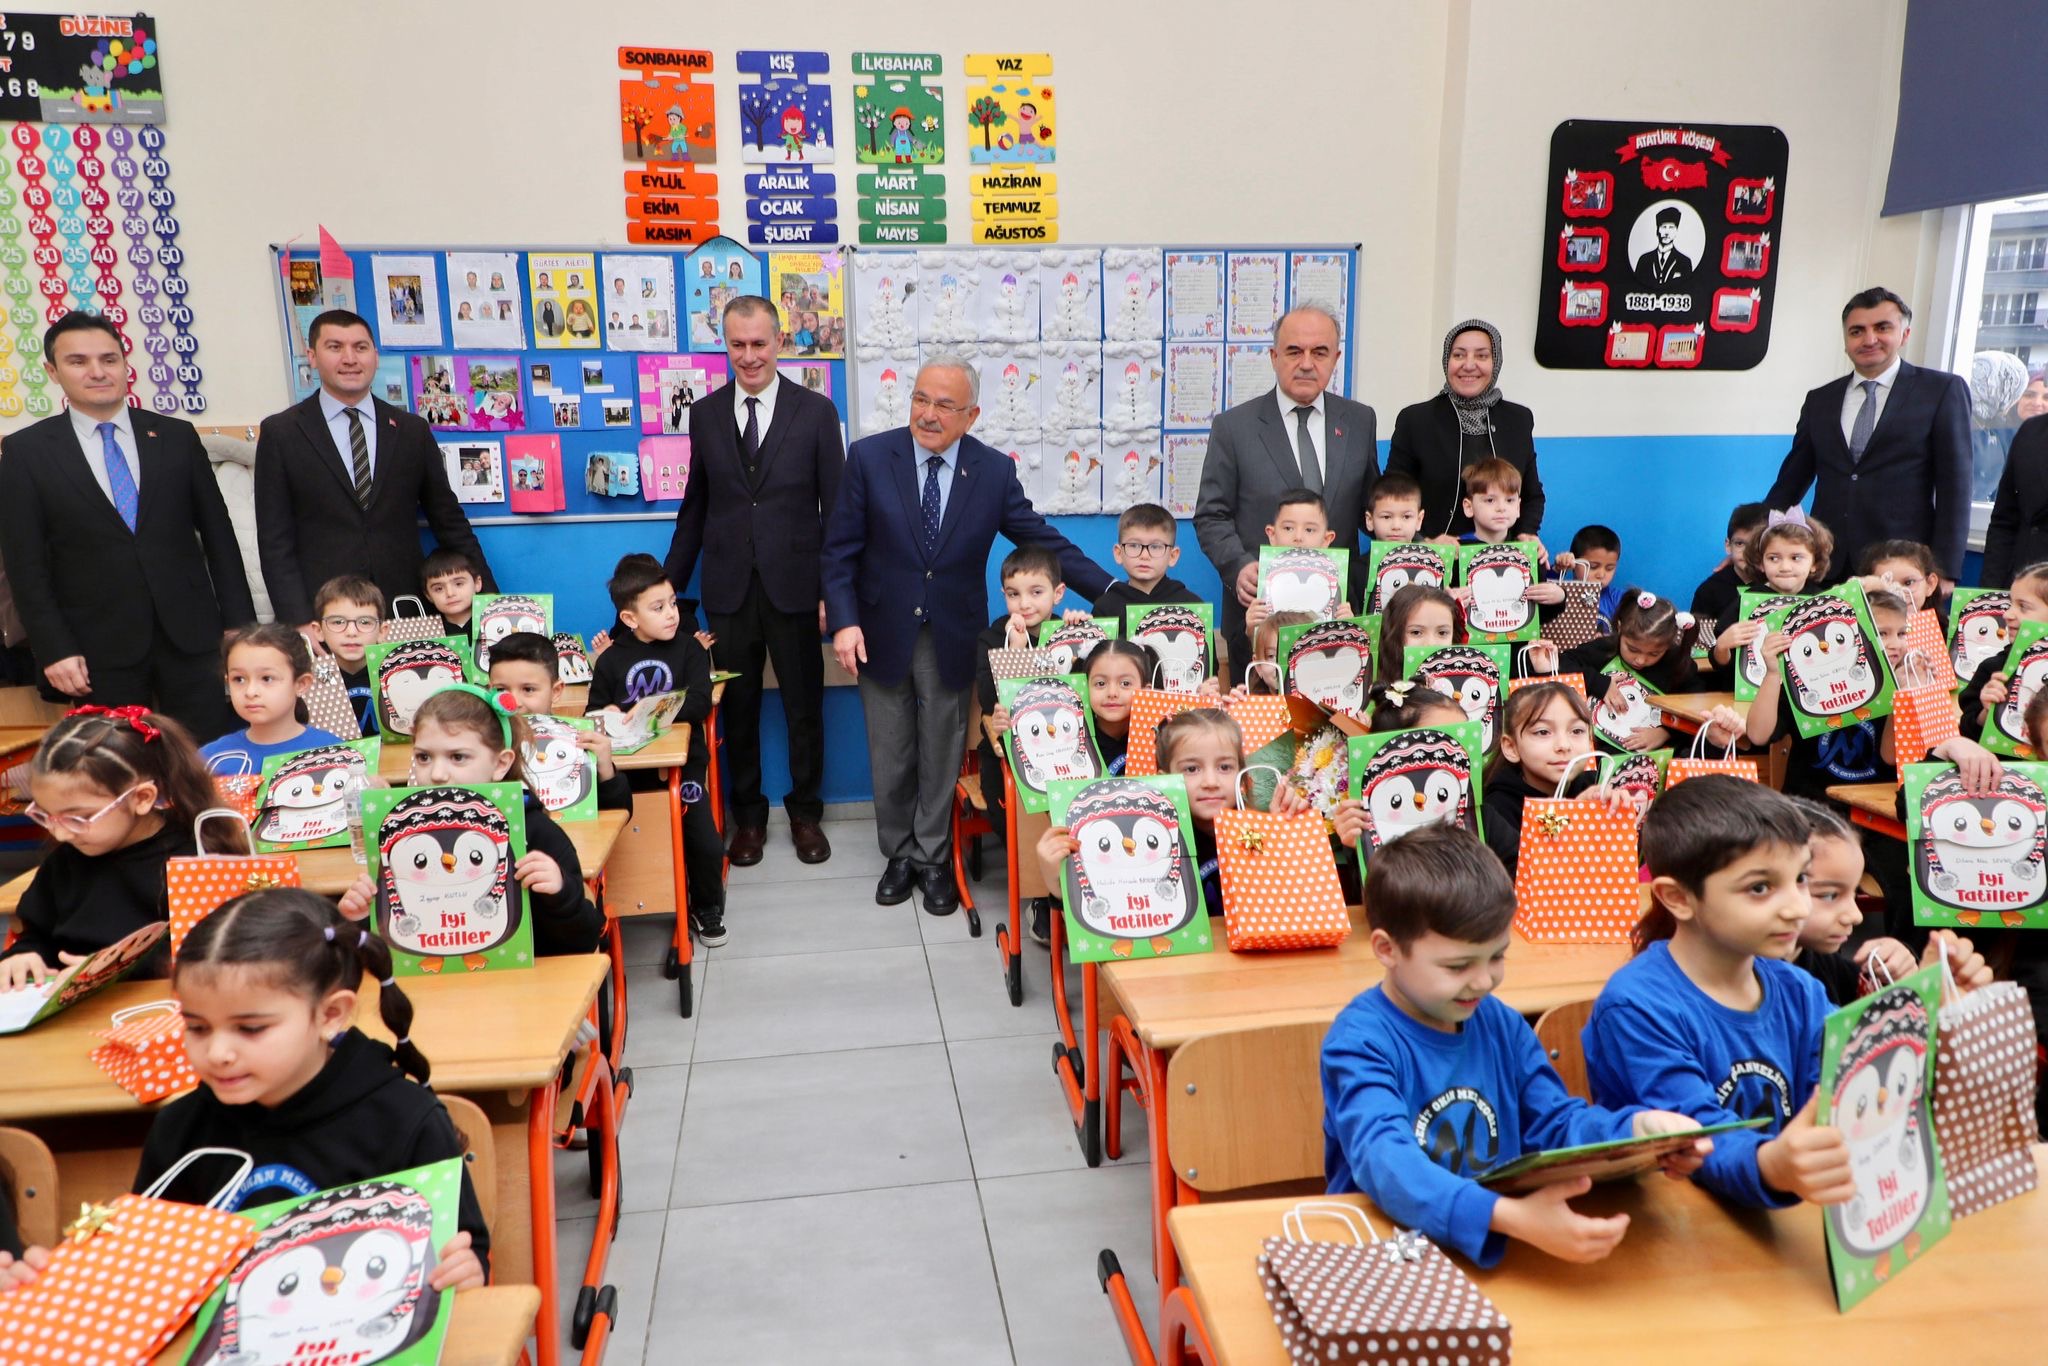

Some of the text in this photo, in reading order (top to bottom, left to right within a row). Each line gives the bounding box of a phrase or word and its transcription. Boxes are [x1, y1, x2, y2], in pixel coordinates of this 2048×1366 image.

[60, 15, 133, 37] DÜZİNE
[3, 31, 35, 51] 7 9
[625, 50, 708, 68] SONBAHAR
[769, 54, 795, 73] KIŞ
[861, 52, 933, 72] İLKBAHAR
[996, 58, 1023, 71] YAZ
[8, 78, 21, 97] 6
[27, 79, 39, 97] 8
[18, 128, 160, 147] 6 7 8 9 10
[1635, 128, 1716, 152] ATATÜRK KÖŞESİ
[23, 159, 167, 176] 12 14 16 18 20
[641, 173, 687, 190] EYLÜL
[758, 175, 810, 190] ARALIK
[874, 175, 918, 191] MART
[982, 173, 1042, 189] HAZİRAN
[28, 190, 45, 206] 18
[56, 189, 74, 206] 21
[84, 190, 104, 206] 24
[119, 190, 139, 206] 27
[150, 190, 172, 206] 30
[643, 197, 680, 215] EKİM
[759, 200, 804, 215] OCAK
[875, 198, 920, 215] NİSAN
[983, 201, 1042, 214] TEMMUZ
[31, 219, 52, 234] 24
[60, 218, 82, 234] 28
[88, 218, 109, 234] 32
[125, 219, 146, 235] 36
[154, 219, 176, 234] 40
[645, 225, 692, 241] KASIM
[764, 226, 813, 243] ŞUBAT
[876, 226, 919, 242] MAYIS
[984, 222, 1046, 240] AĞUSTOS
[2, 248, 181, 264] 25 30 35 40 45 50
[6, 278, 186, 294] 30 36 42 48 54 60
[1626, 294, 1692, 311] 1881-1938
[12, 308, 33, 324] 35
[103, 307, 124, 323] 56
[141, 309, 163, 323] 63
[170, 309, 191, 323] 70
[18, 337, 39, 353] 40
[147, 338, 168, 352] 72
[174, 338, 195, 353] 80
[23, 367, 43, 383] 45
[152, 368, 168, 382] 81
[179, 367, 199, 382] 90
[27, 396, 48, 412] 50
[155, 397, 175, 412] 90
[182, 396, 206, 411] 100
[1484, 619, 1521, 628] Tatiller
[1829, 680, 1848, 694] İyi
[1819, 689, 1867, 711] Tatiller
[280, 827, 337, 840] Tatiller
[1977, 870, 2004, 887] İyi
[1126, 892, 1151, 911] İyi
[1955, 889, 2030, 903] Tatiller
[440, 909, 466, 928] İyi
[1107, 912, 1174, 931] Tatiller
[417, 930, 491, 948] Tatiller
[1866, 1190, 1919, 1243] Tatiller
